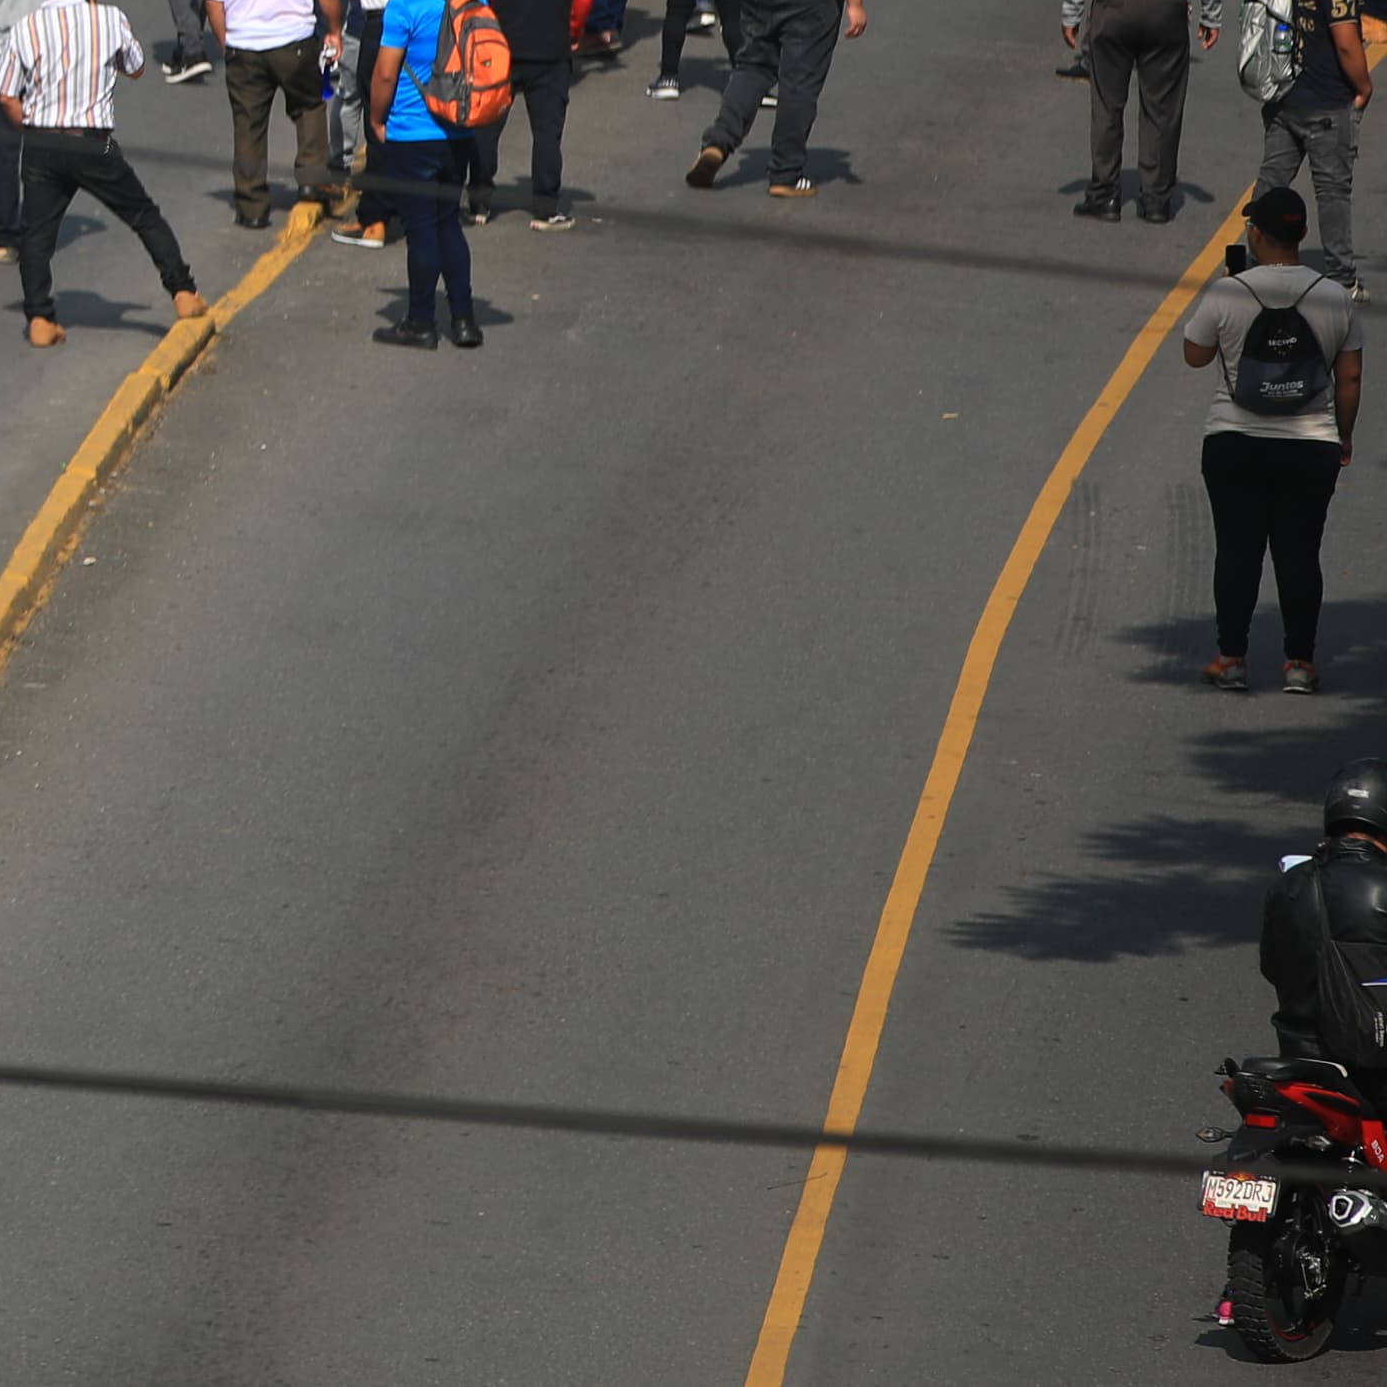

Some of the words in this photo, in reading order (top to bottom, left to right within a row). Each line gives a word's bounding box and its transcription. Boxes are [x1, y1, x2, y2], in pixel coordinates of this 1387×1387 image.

[1259, 380, 1304, 393] Juntos
[1207, 1178, 1274, 1204] M592DRJ
[1203, 1199, 1235, 1219] Red
[1236, 1205, 1268, 1223] Bull
